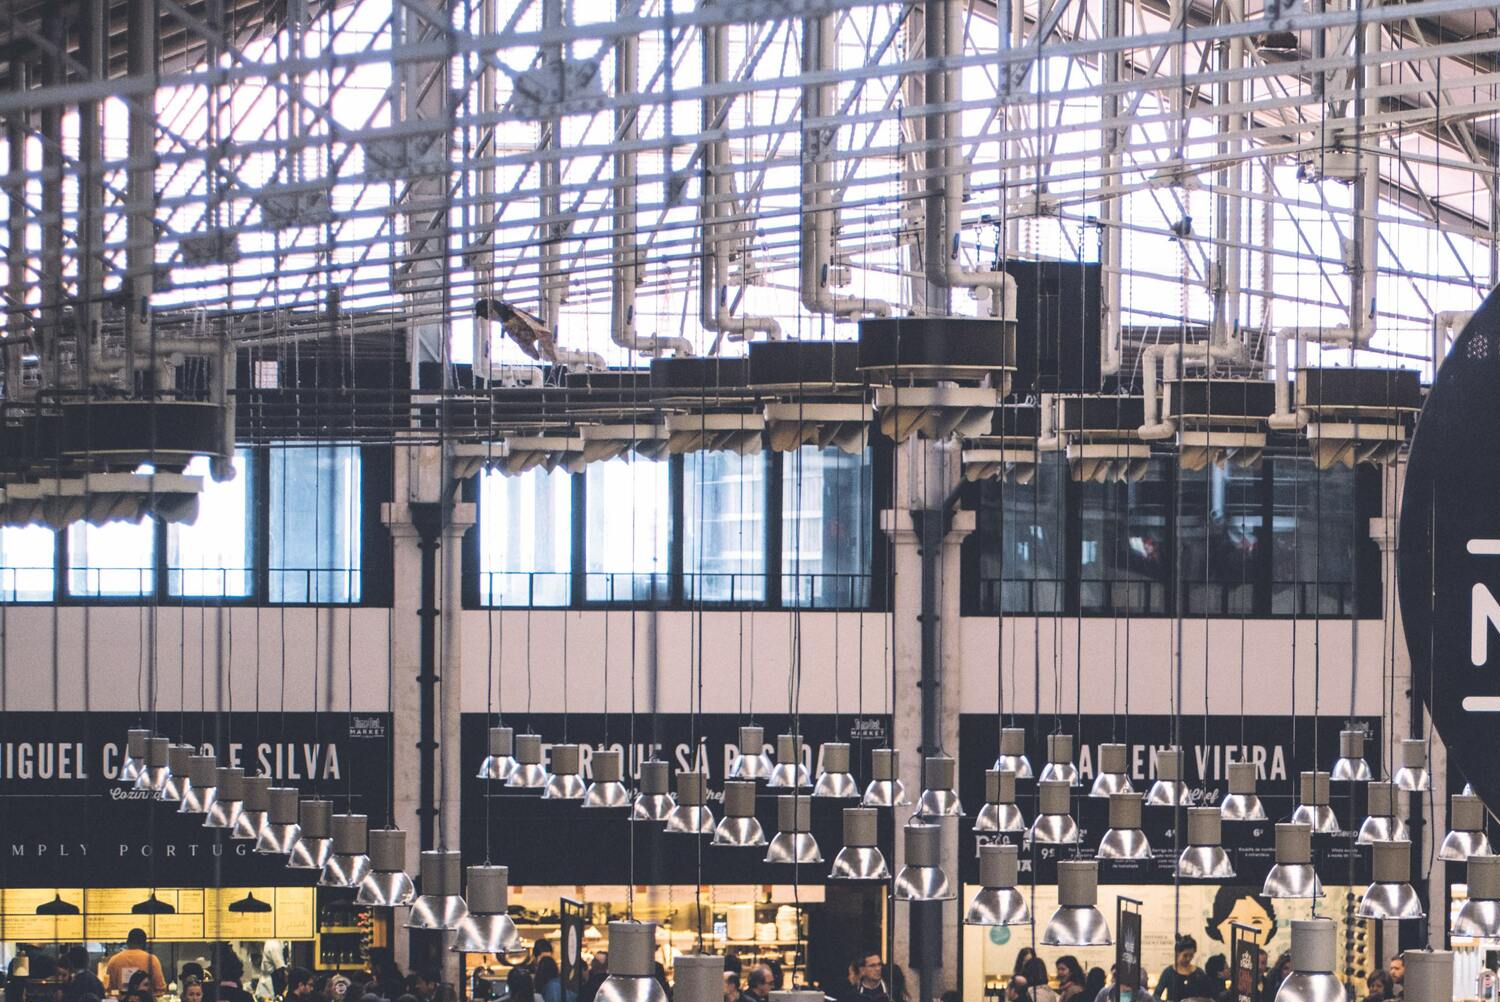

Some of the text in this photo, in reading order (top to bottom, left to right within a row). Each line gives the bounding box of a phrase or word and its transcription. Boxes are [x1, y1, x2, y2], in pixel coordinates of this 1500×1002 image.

[0, 742, 88, 779] IGUEL
[257, 743, 341, 780] SILVA
[674, 736, 711, 779] SÁ
[12, 844, 268, 856] MPLY PORTUG
